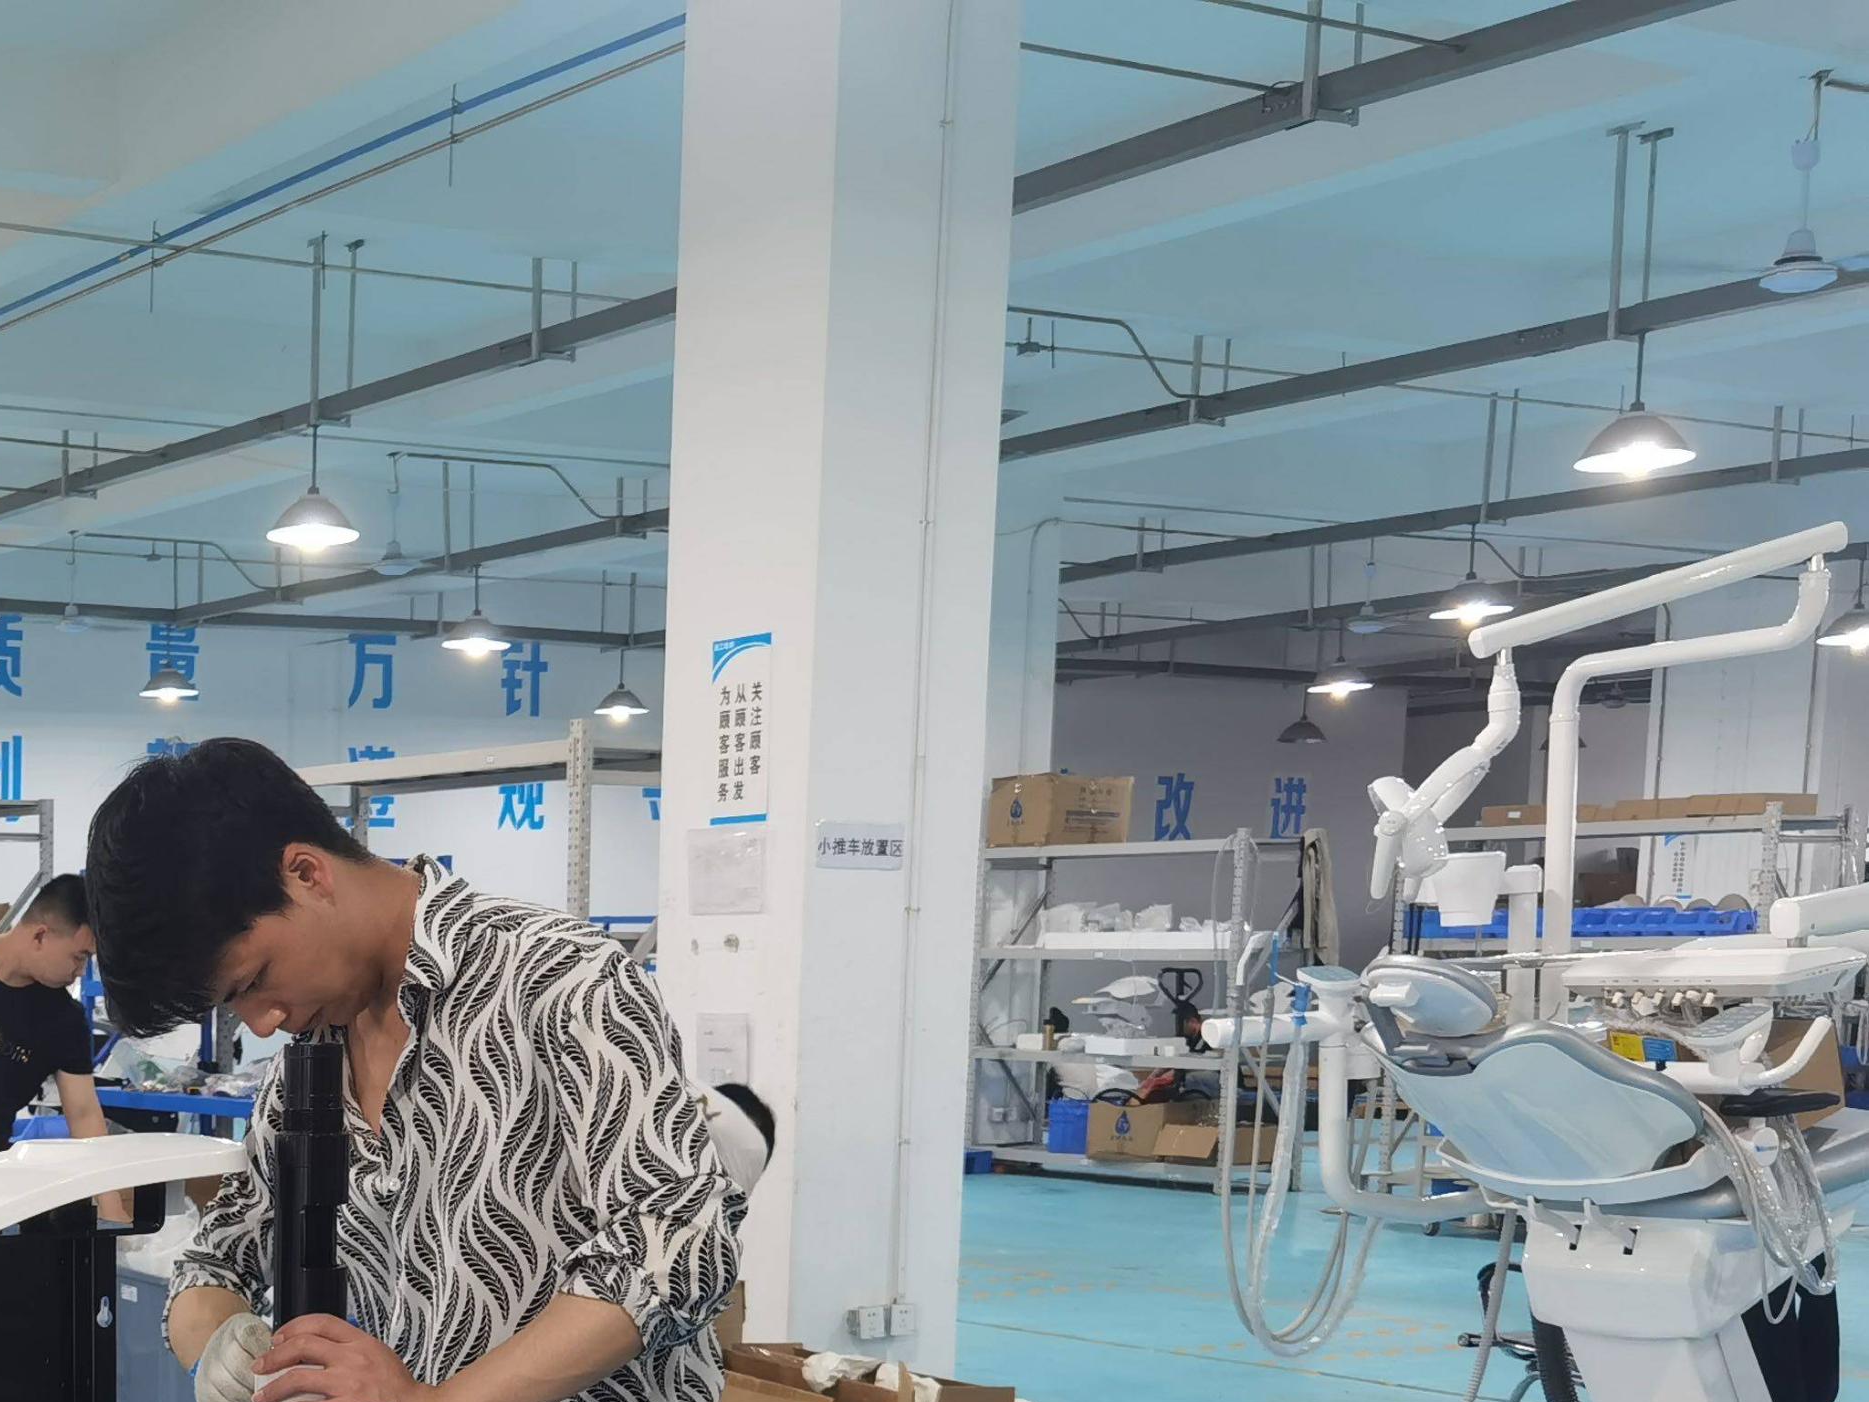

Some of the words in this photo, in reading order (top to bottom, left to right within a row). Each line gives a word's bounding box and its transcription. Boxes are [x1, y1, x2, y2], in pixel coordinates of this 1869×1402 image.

[717, 686, 731, 802] 为顾客服务
[732, 683, 747, 801] 从顾客出发
[749, 681, 763, 775] 关注顾客
[817, 837, 904, 857] 小推车放置区
[1154, 773, 1308, 841] 改进
